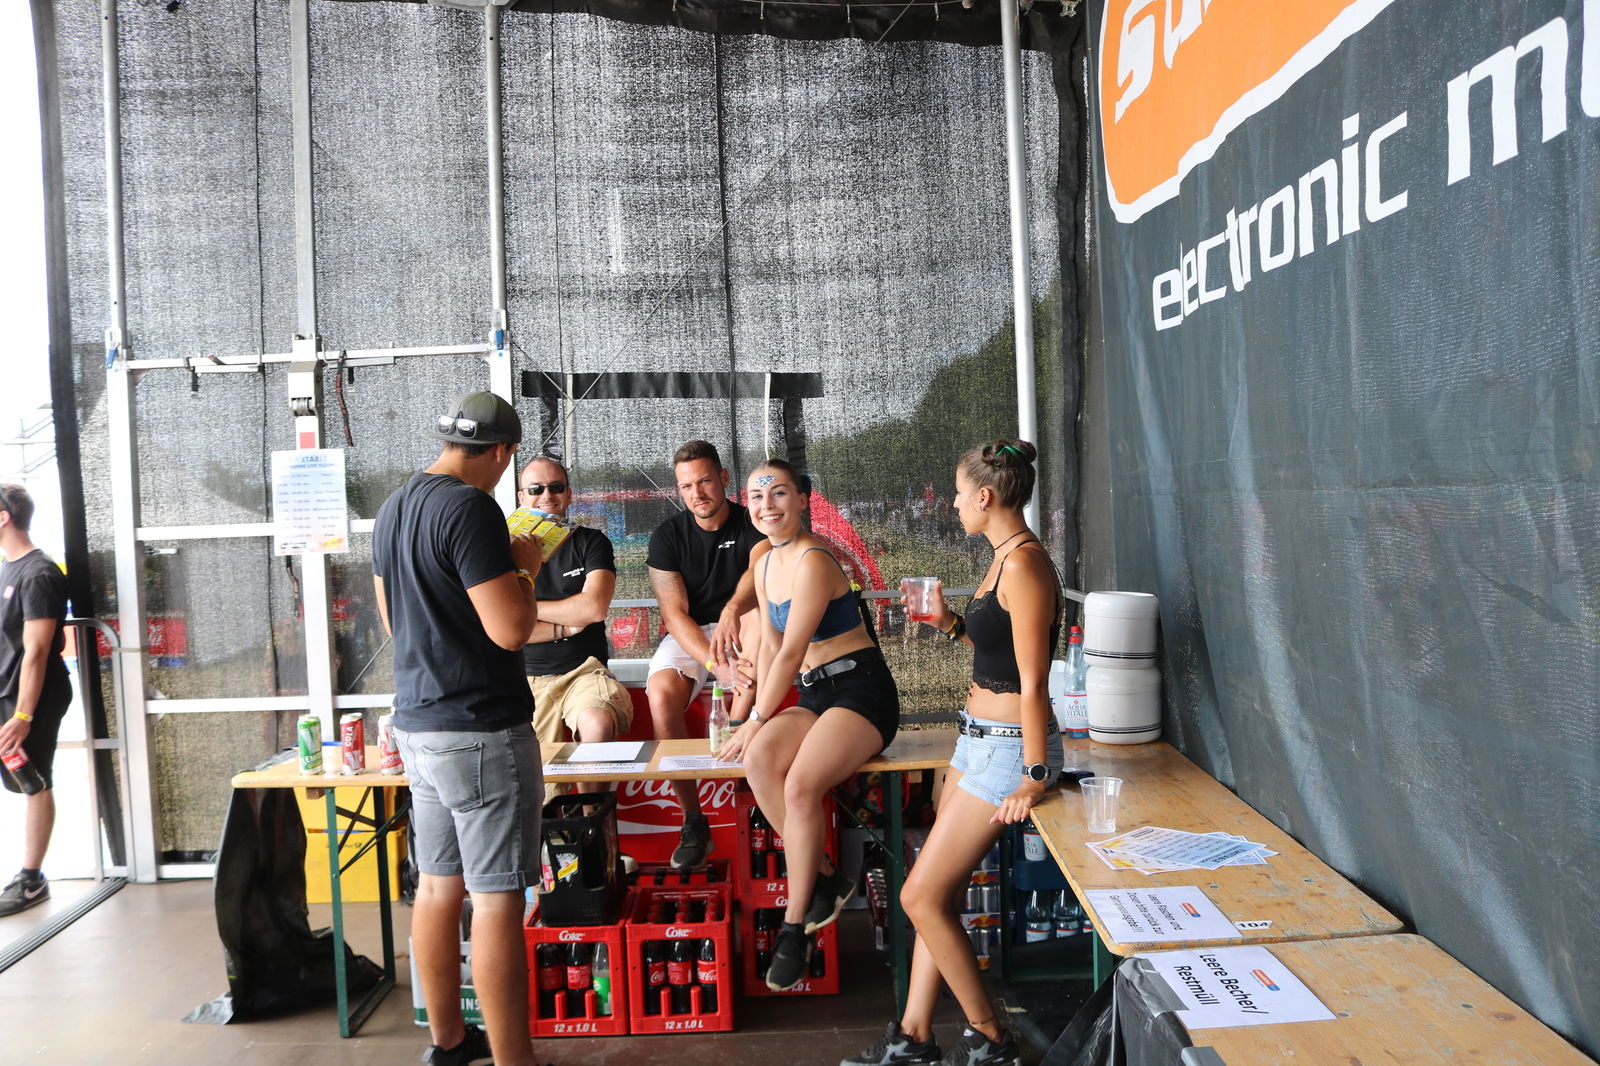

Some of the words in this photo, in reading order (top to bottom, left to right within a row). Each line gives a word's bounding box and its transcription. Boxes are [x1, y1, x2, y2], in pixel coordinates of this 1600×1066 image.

[344, 725, 354, 748] COLA
[766, 883, 776, 892] 12
[775, 896, 788, 907] Co
[1157, 904, 1176, 921] Flaschen
[1169, 921, 1186, 930] und
[1238, 921, 1268, 929] 104
[559, 930, 585, 941] Coke
[665, 926, 691, 938] Coke
[805, 982, 812, 992] L
[1173, 965, 1221, 1005] Restmüll
[1199, 954, 1229, 977] Leere
[1220, 978, 1270, 1015] Becher/
[554, 1024, 565, 1033] 12
[567, 1025, 574, 1033] x
[576, 1023, 590, 1033] 1.0
[591, 1023, 598, 1032] L
[665, 1021, 675, 1030] 12
[684, 1020, 698, 1029] 1.0
[698, 1019, 704, 1028] L
